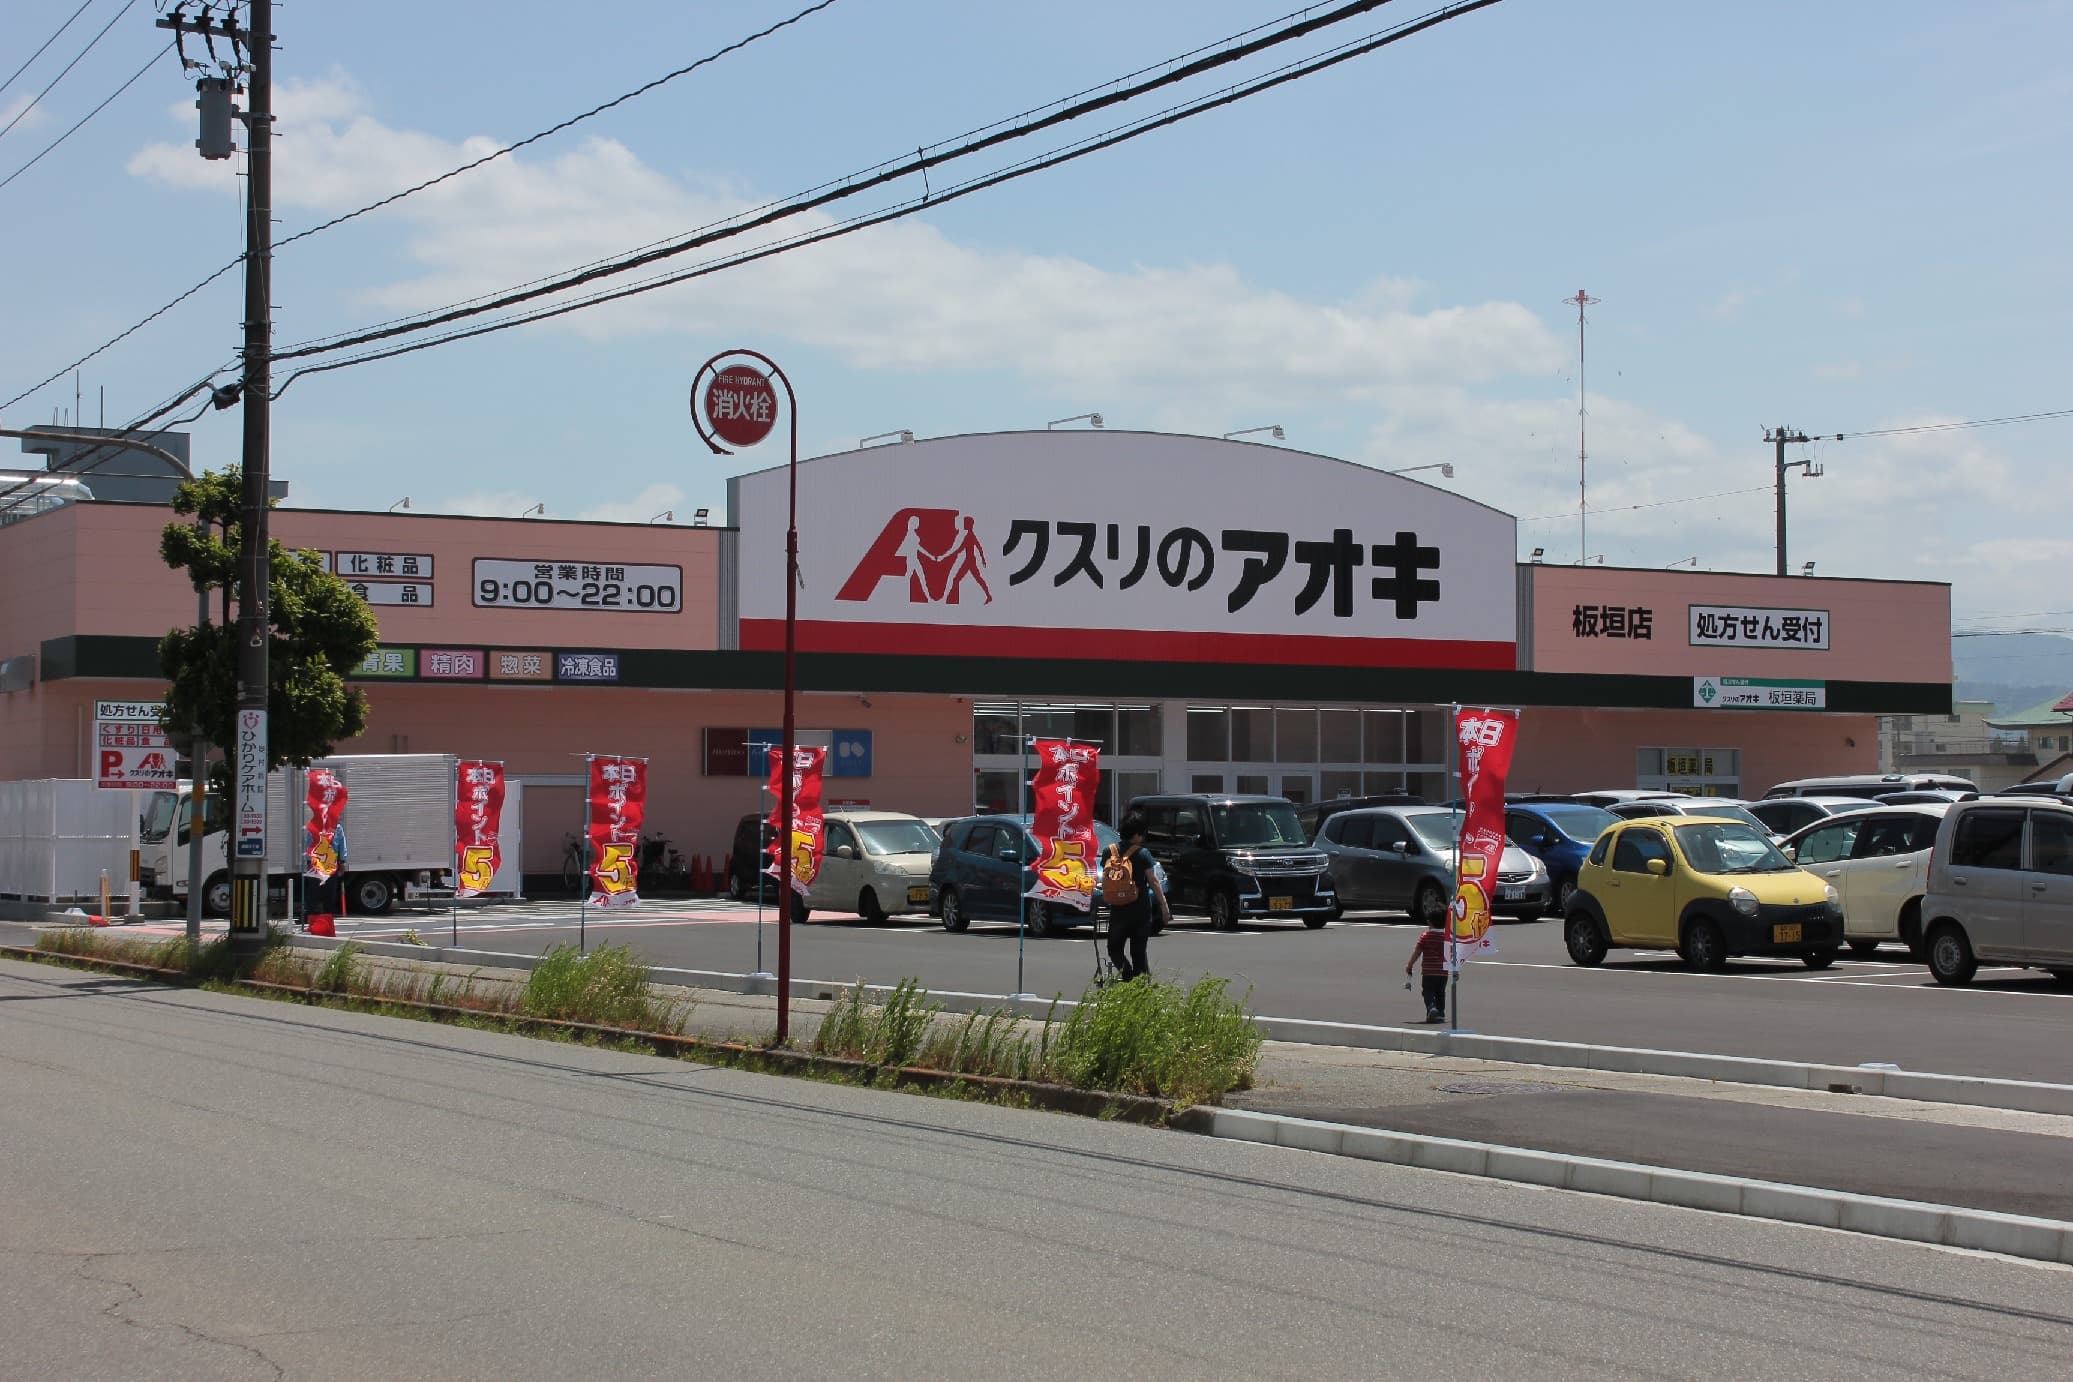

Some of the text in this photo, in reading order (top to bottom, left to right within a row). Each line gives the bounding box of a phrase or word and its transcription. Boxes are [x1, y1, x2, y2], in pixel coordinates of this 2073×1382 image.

[718, 375, 766, 387] FIRE HYDRANT
[712, 388, 772, 422] 消火栓
[350, 554, 419, 575] 化粧品
[533, 564, 626, 583] 営業時間
[1002, 519, 1441, 620] クスリのアオキ
[1572, 604, 1653, 641] 板垣店
[1696, 612, 1823, 644] 処方せん受付
[362, 652, 405, 673] 青果
[430, 653, 475, 675] 精肉
[500, 654, 542, 675] 惣菜
[560, 656, 617, 678] 冷凍食品
[1768, 690, 1817, 706] 板垣薬局
[100, 703, 168, 717] 処方せん受
[103, 725, 135, 735] くすり
[1458, 717, 1504, 746] 本日
[101, 750, 124, 778] P
[1048, 744, 1090, 764] 本日
[241, 730, 257, 813] ひかりケアホーム
[465, 767, 496, 786] 本日
[602, 763, 637, 784] 本日
[460, 845, 494, 892] 5
